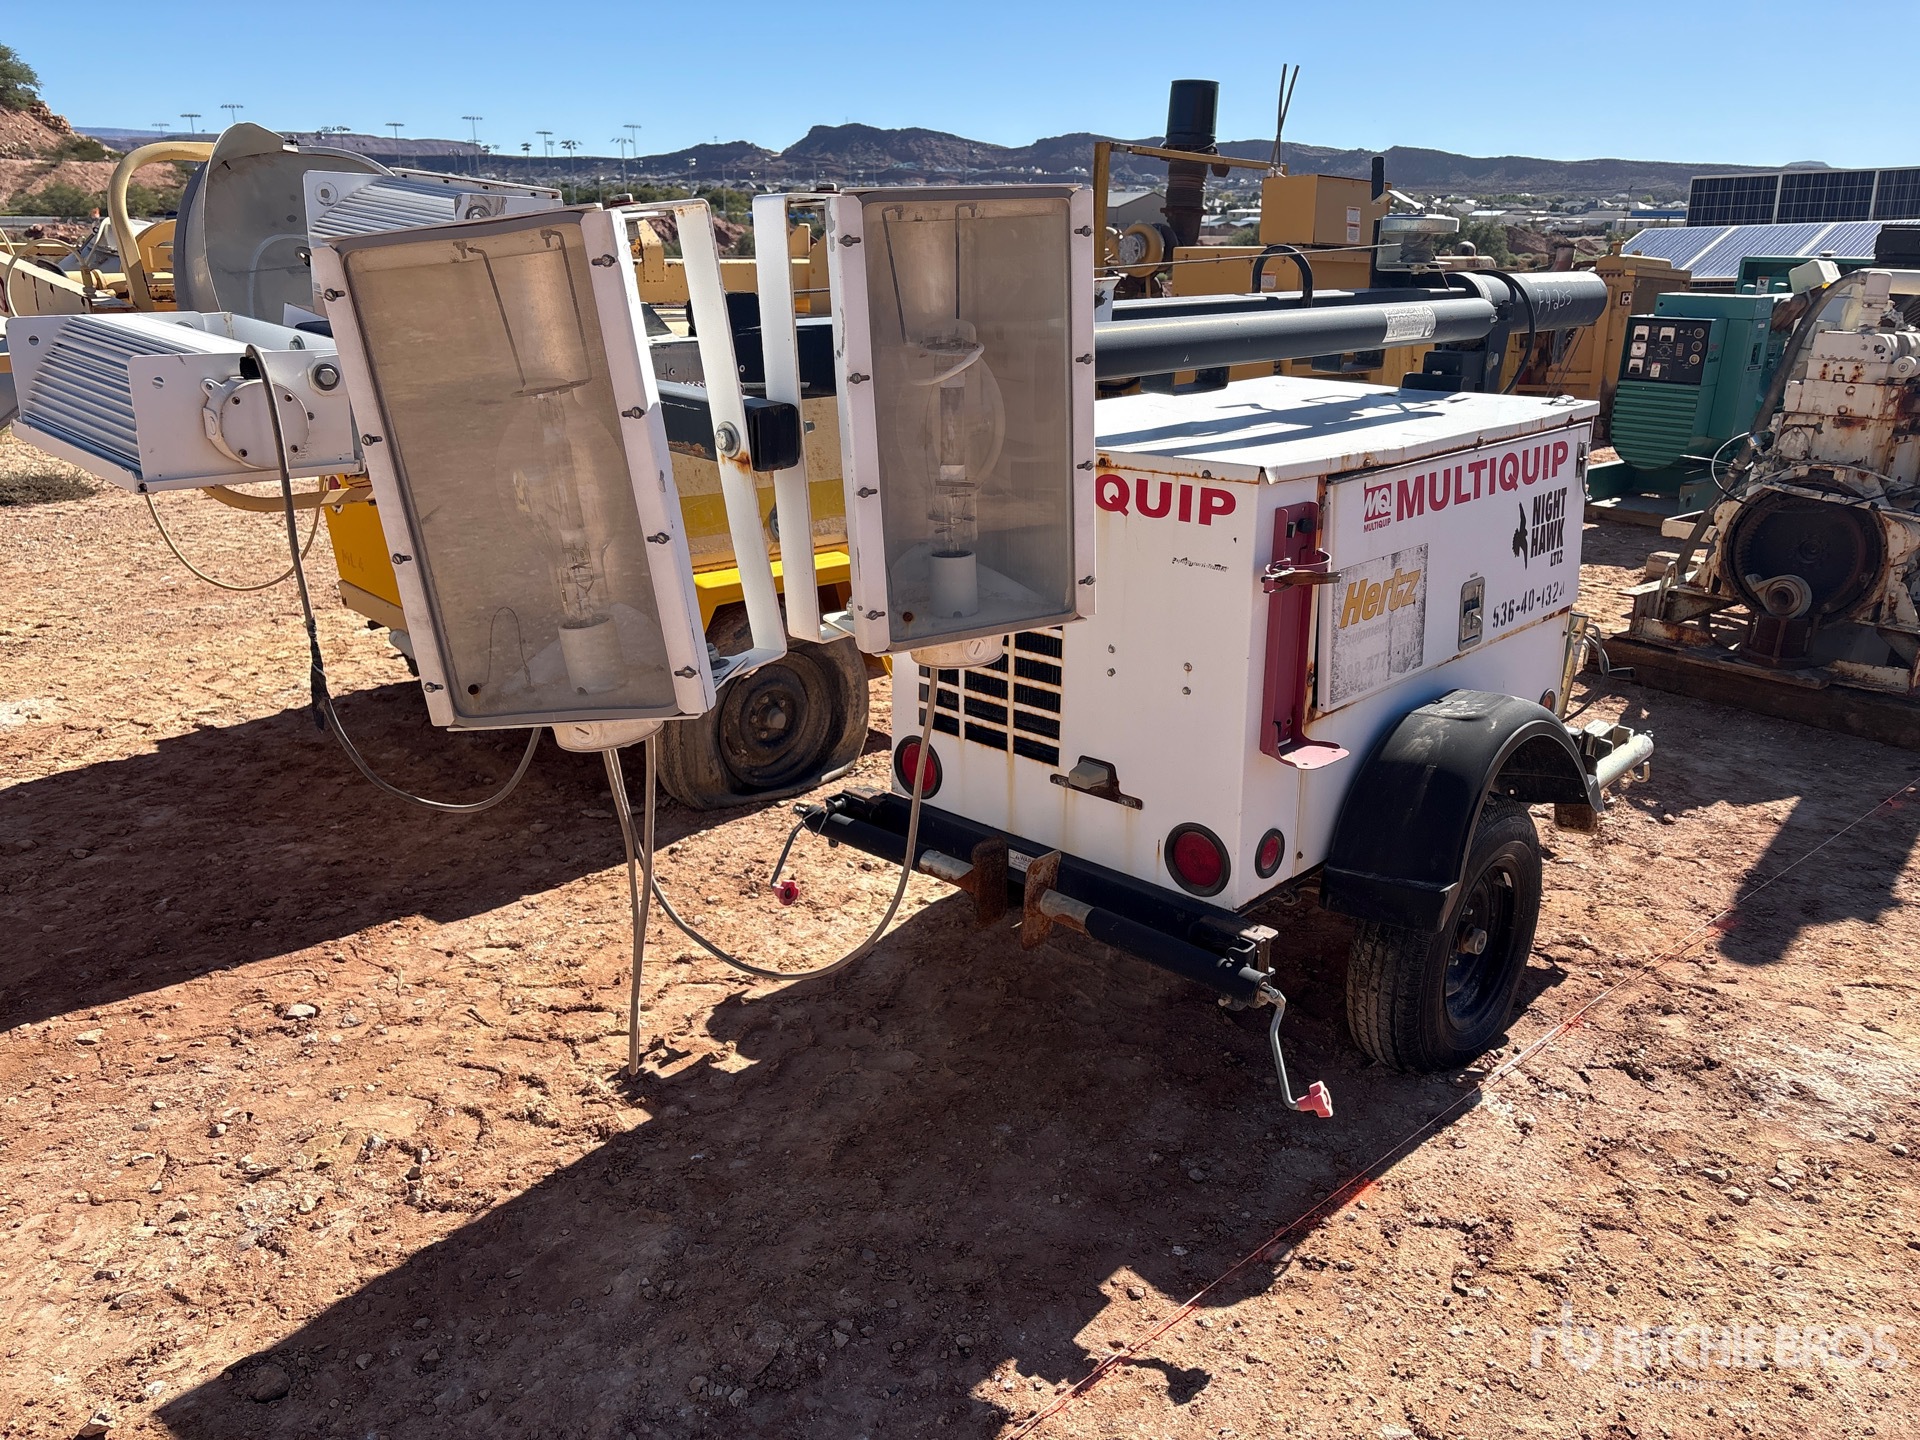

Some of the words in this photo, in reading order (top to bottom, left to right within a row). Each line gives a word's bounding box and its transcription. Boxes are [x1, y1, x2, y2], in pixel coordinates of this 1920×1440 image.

[1095, 473, 1237, 526] QUIP
[1396, 440, 1569, 522] MULTIQUIP
[1363, 517, 1391, 533] MULTIQUIP
[1532, 487, 1567, 527] NIGHT
[1530, 518, 1565, 558] HAWK
[1339, 567, 1421, 629] Hertz
